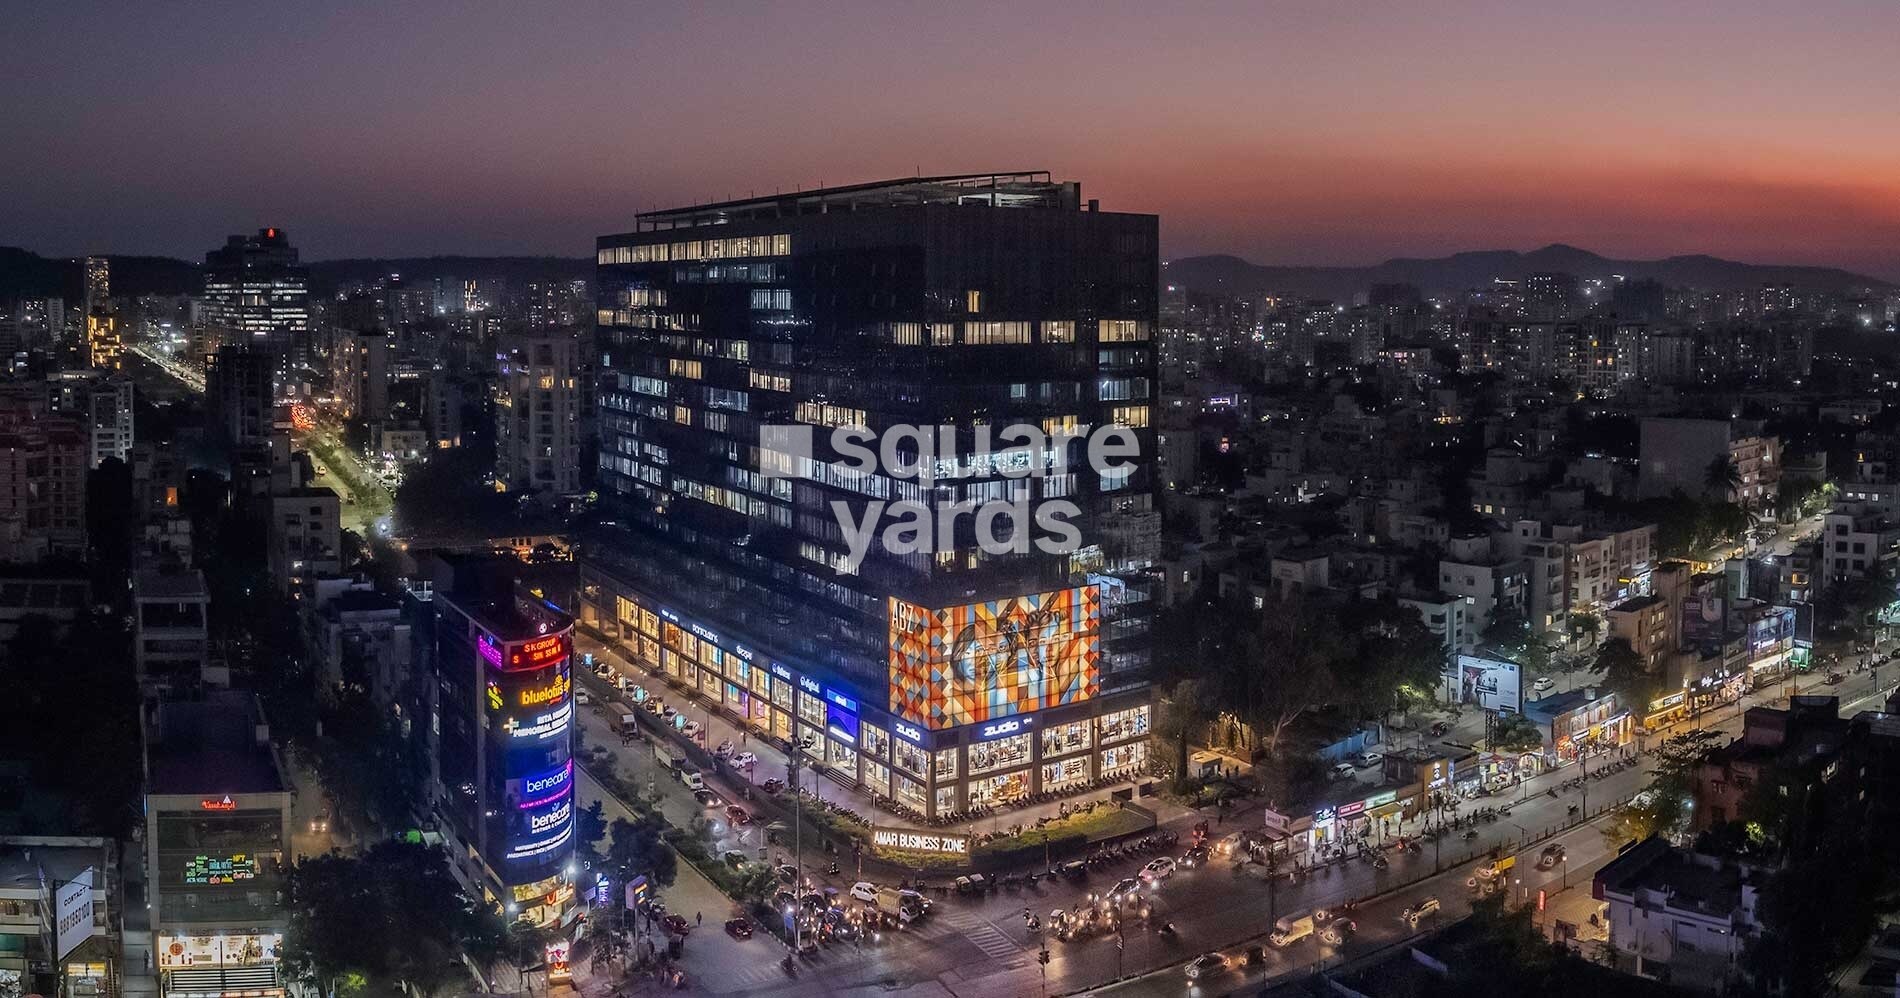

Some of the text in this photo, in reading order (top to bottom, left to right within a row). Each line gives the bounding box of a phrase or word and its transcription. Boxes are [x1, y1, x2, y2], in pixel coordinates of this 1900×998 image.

[892, 601, 914, 634] ABZ
[522, 686, 563, 705] bluelotus
[527, 769, 569, 793] benecare
[532, 803, 570, 829] benecare
[874, 831, 965, 853] AMAR BUSINESS ZONE
[64, 886, 87, 907] CONTACT
